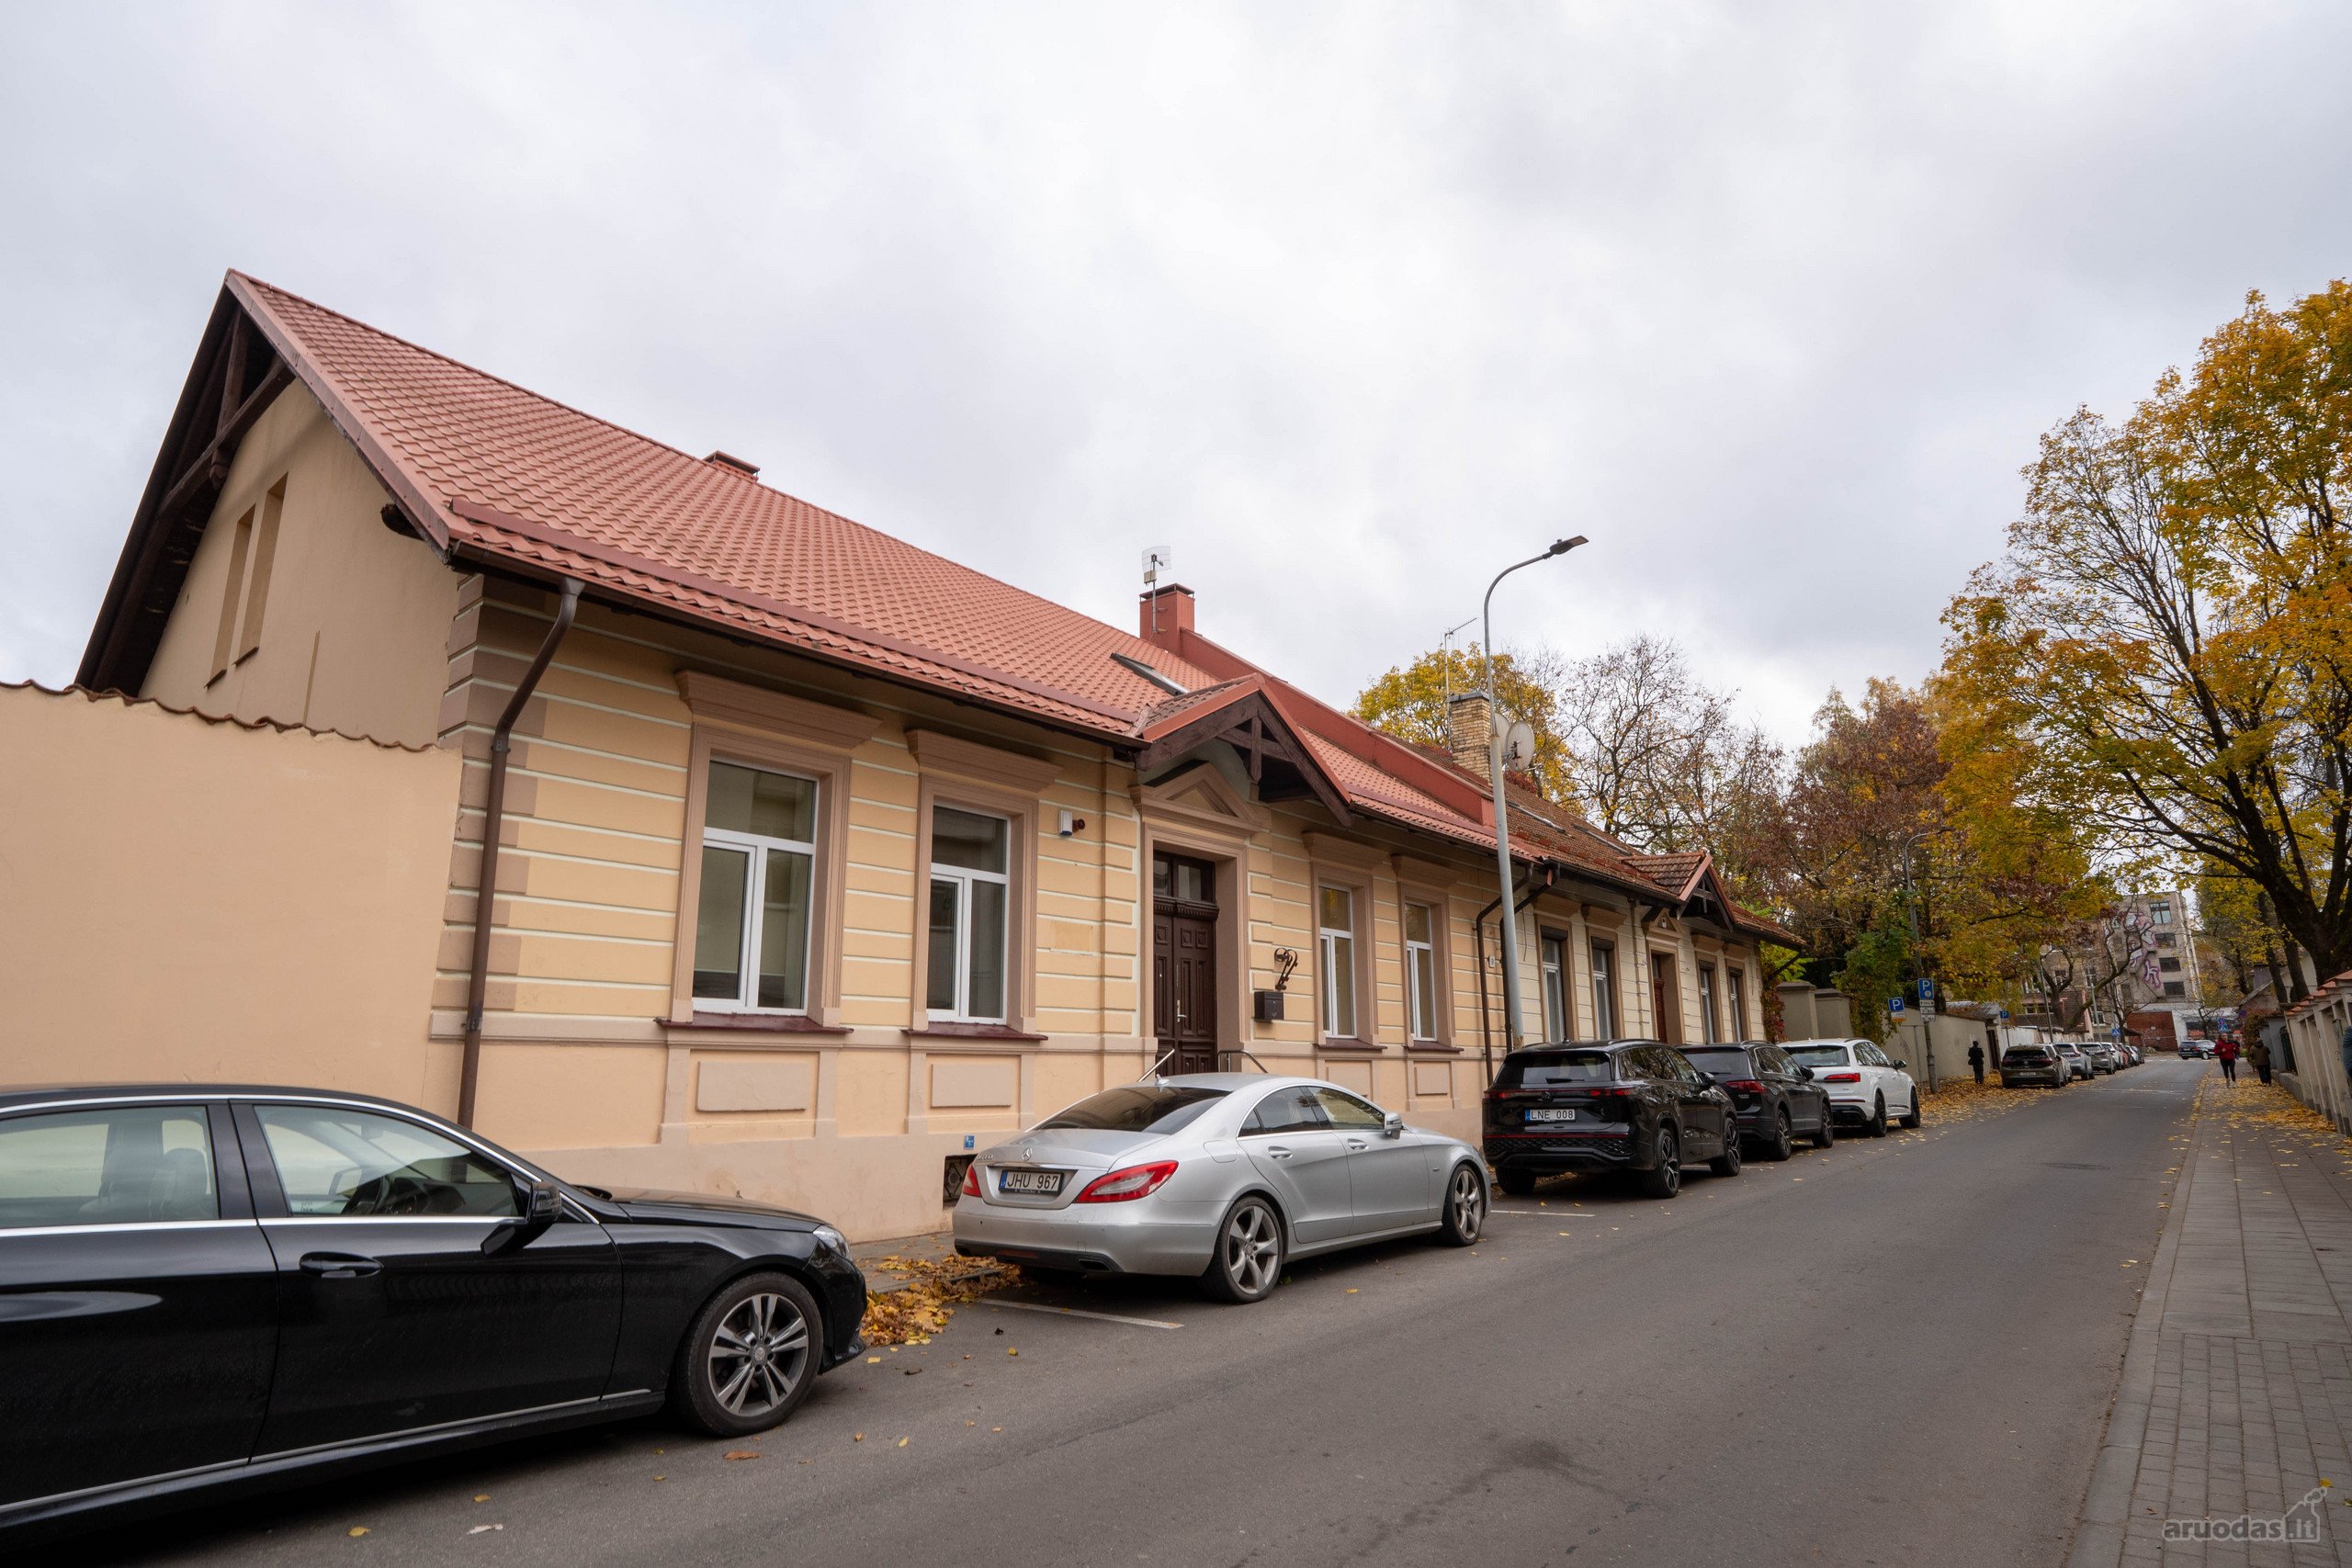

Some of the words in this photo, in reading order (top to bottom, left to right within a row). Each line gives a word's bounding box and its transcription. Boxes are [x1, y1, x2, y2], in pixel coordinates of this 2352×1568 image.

[1922, 980, 1930, 991] P
[1893, 999, 1901, 1010] P
[1531, 1110, 1550, 1120] LNE
[1556, 1110, 1574, 1119] 008
[1007, 1173, 1032, 1189] JHU
[1036, 1174, 1058, 1190] 967
